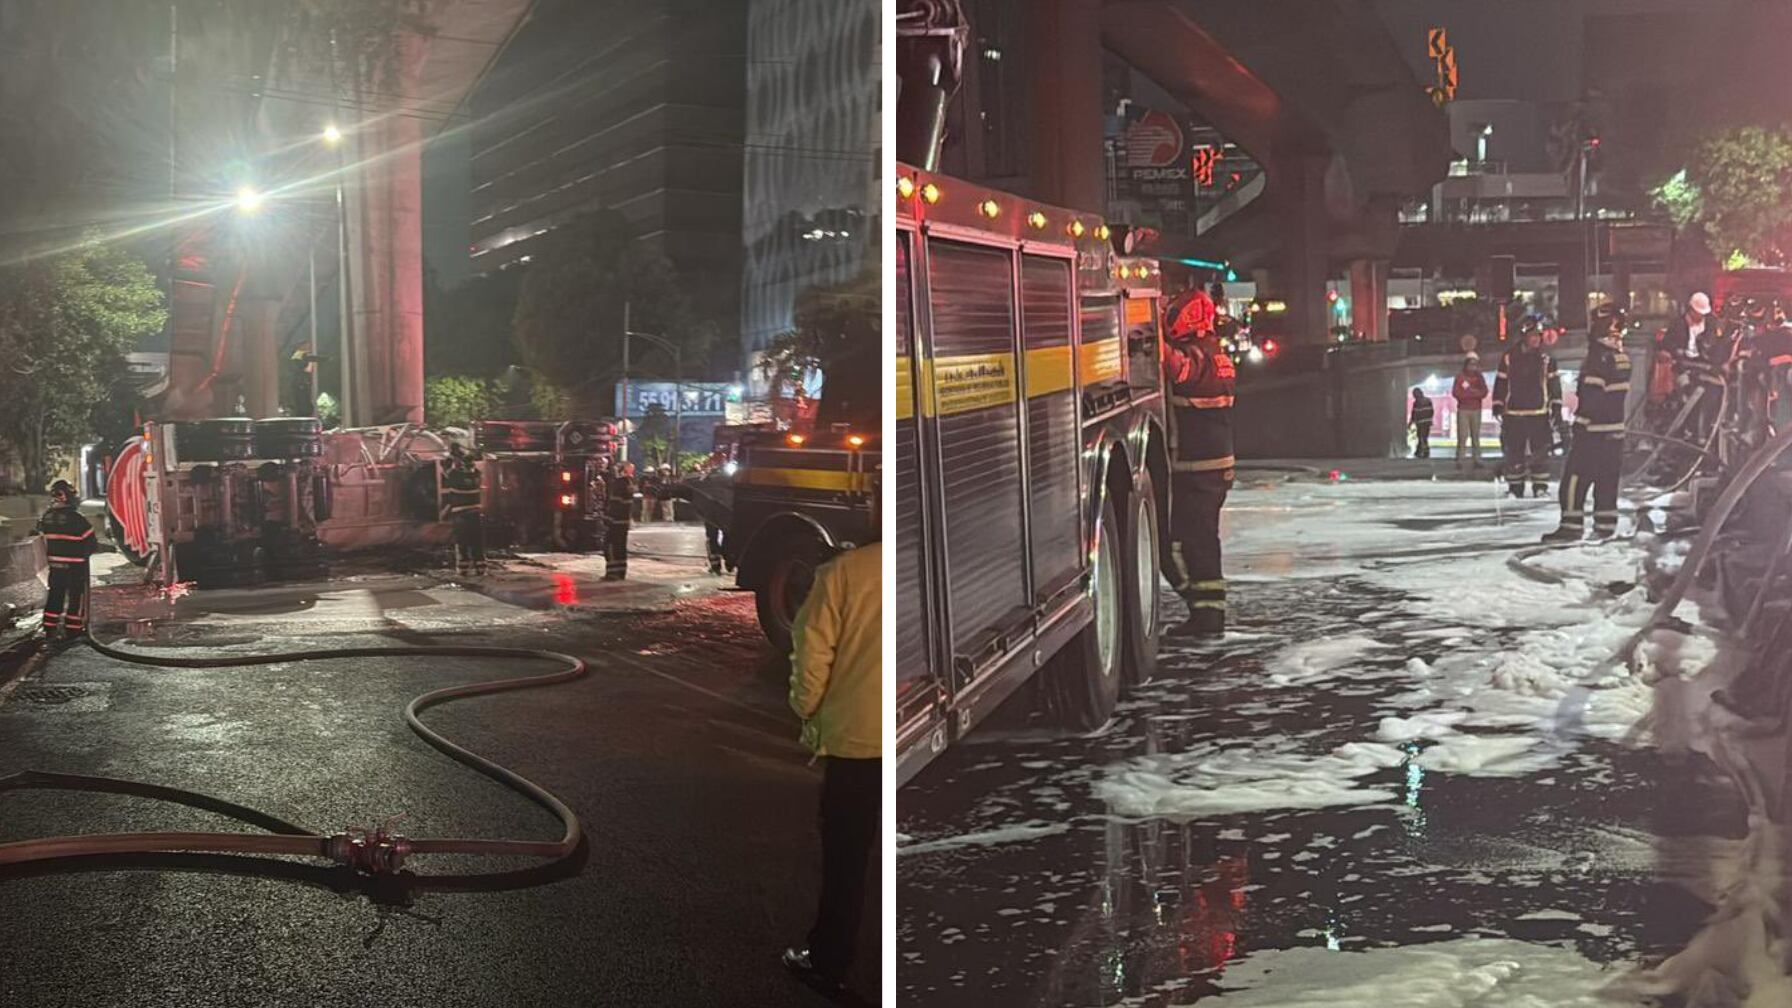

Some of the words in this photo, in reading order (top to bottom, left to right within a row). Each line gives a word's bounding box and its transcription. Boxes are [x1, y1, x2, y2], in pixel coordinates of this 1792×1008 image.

[1133, 168, 1186, 180] PEMEX
[661, 391, 678, 411] 91
[703, 391, 721, 411] 71
